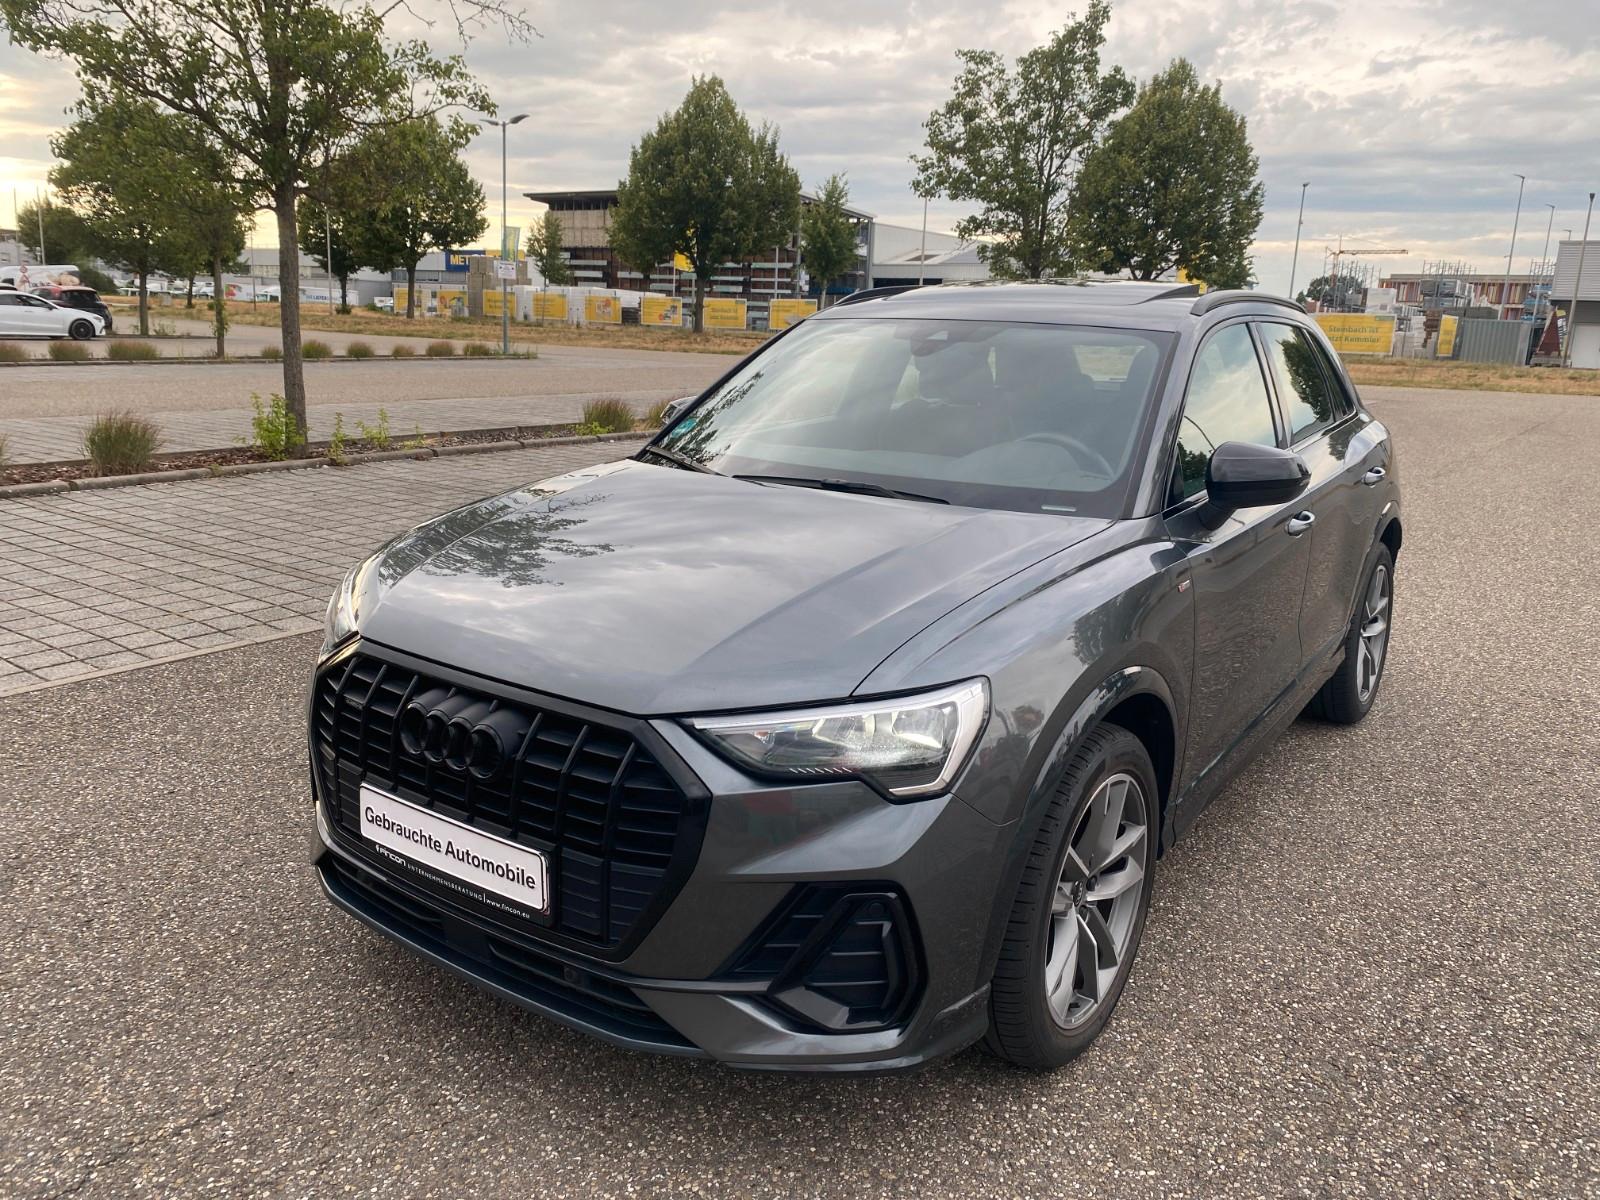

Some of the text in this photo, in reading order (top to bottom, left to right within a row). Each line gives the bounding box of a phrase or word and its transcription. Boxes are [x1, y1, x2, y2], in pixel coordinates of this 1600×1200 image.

[365, 806, 536, 889] Gebrauchte Automobile
[407, 863, 482, 901] UNTERNEHMENSBERATUNG
[486, 899, 530, 919] www.fincon.eu
